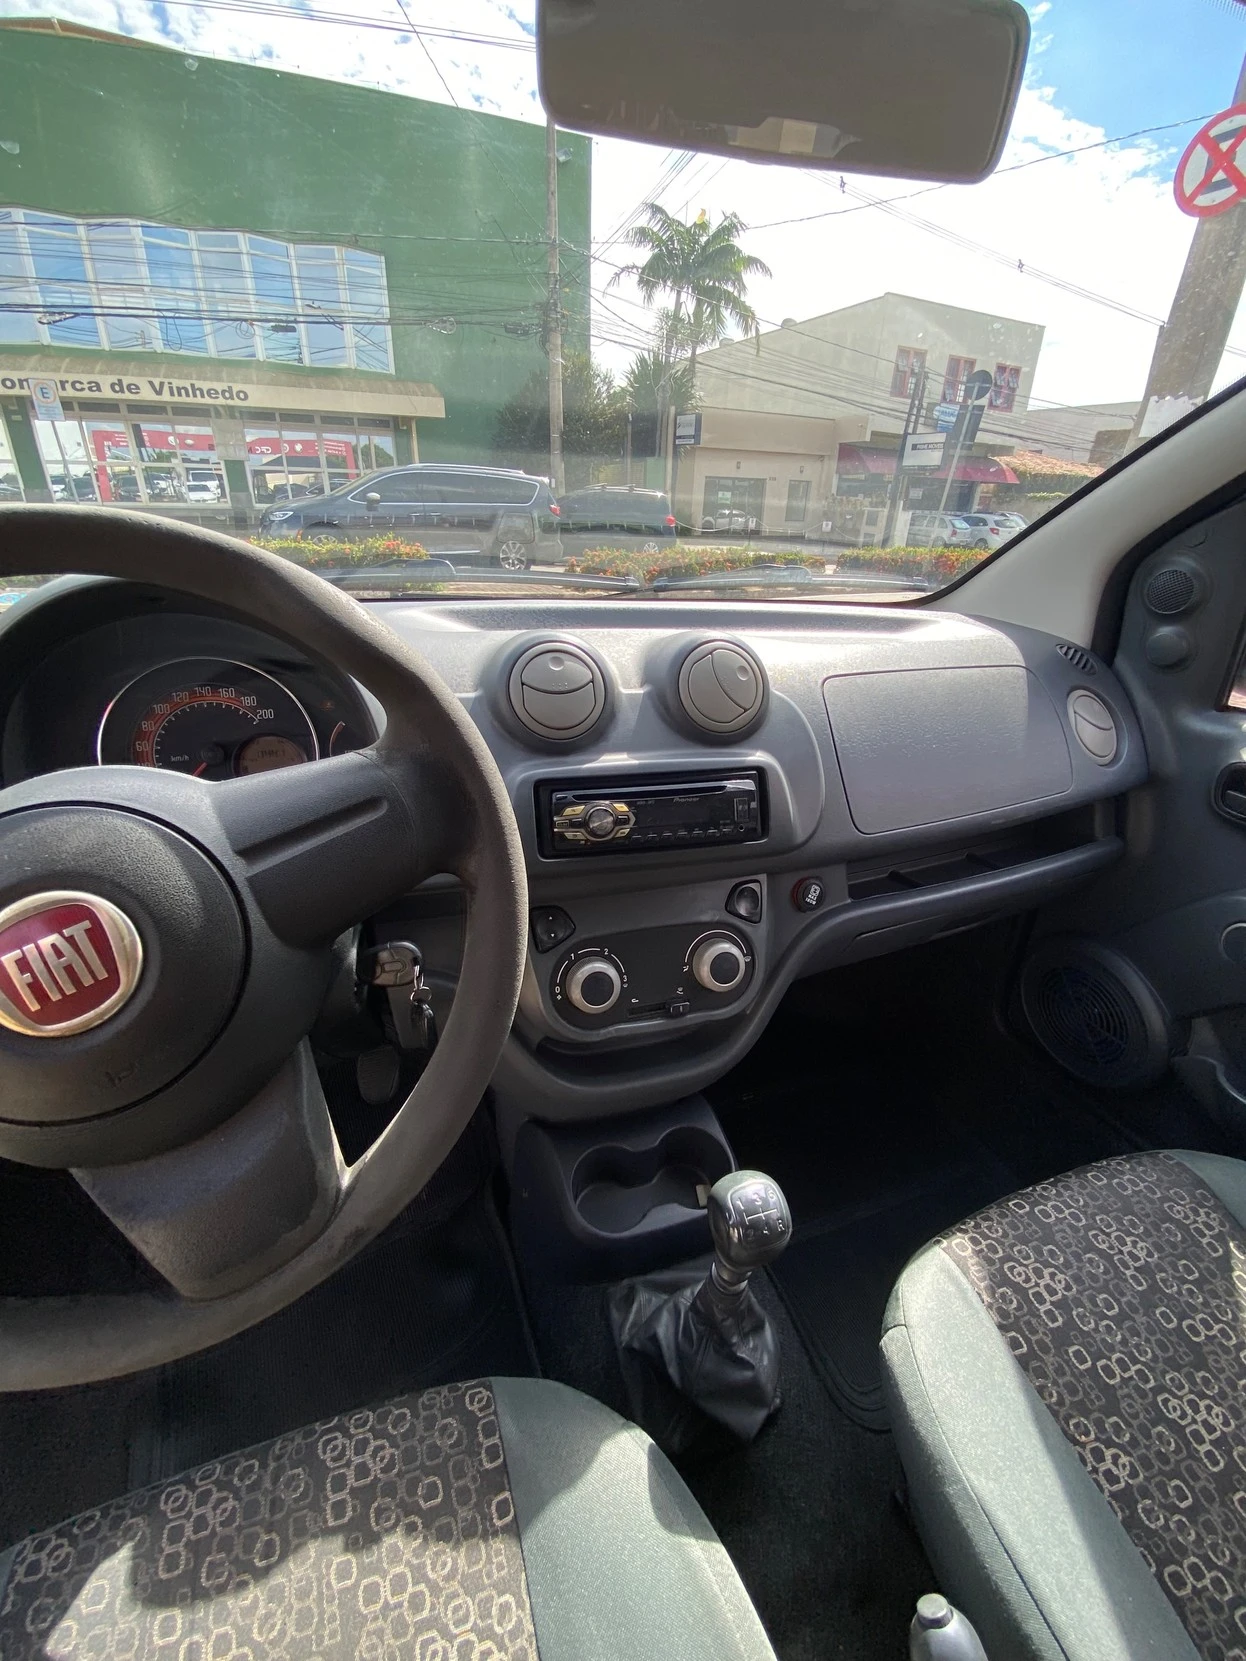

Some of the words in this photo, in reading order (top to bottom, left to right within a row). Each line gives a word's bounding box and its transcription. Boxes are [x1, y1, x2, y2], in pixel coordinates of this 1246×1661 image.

[1, 377, 103, 393] orca
[110, 378, 141, 395] de
[147, 380, 249, 401] Vinhedo
[39, 386, 50, 399] E
[171, 691, 189, 702] 120
[194, 686, 212, 697] 140
[218, 687, 235, 698] 160
[240, 696, 257, 707] 180
[153, 703, 170, 715] 100
[256, 708, 274, 720] 200
[141, 720, 155, 731] 80
[135, 741, 149, 752] 60
[170, 754, 190, 762] km/h
[0, 919, 109, 1012] FIAT
[622, 974, 628, 982] 3
[554, 985, 561, 994] 0
[752, 1192, 763, 1205] 3
